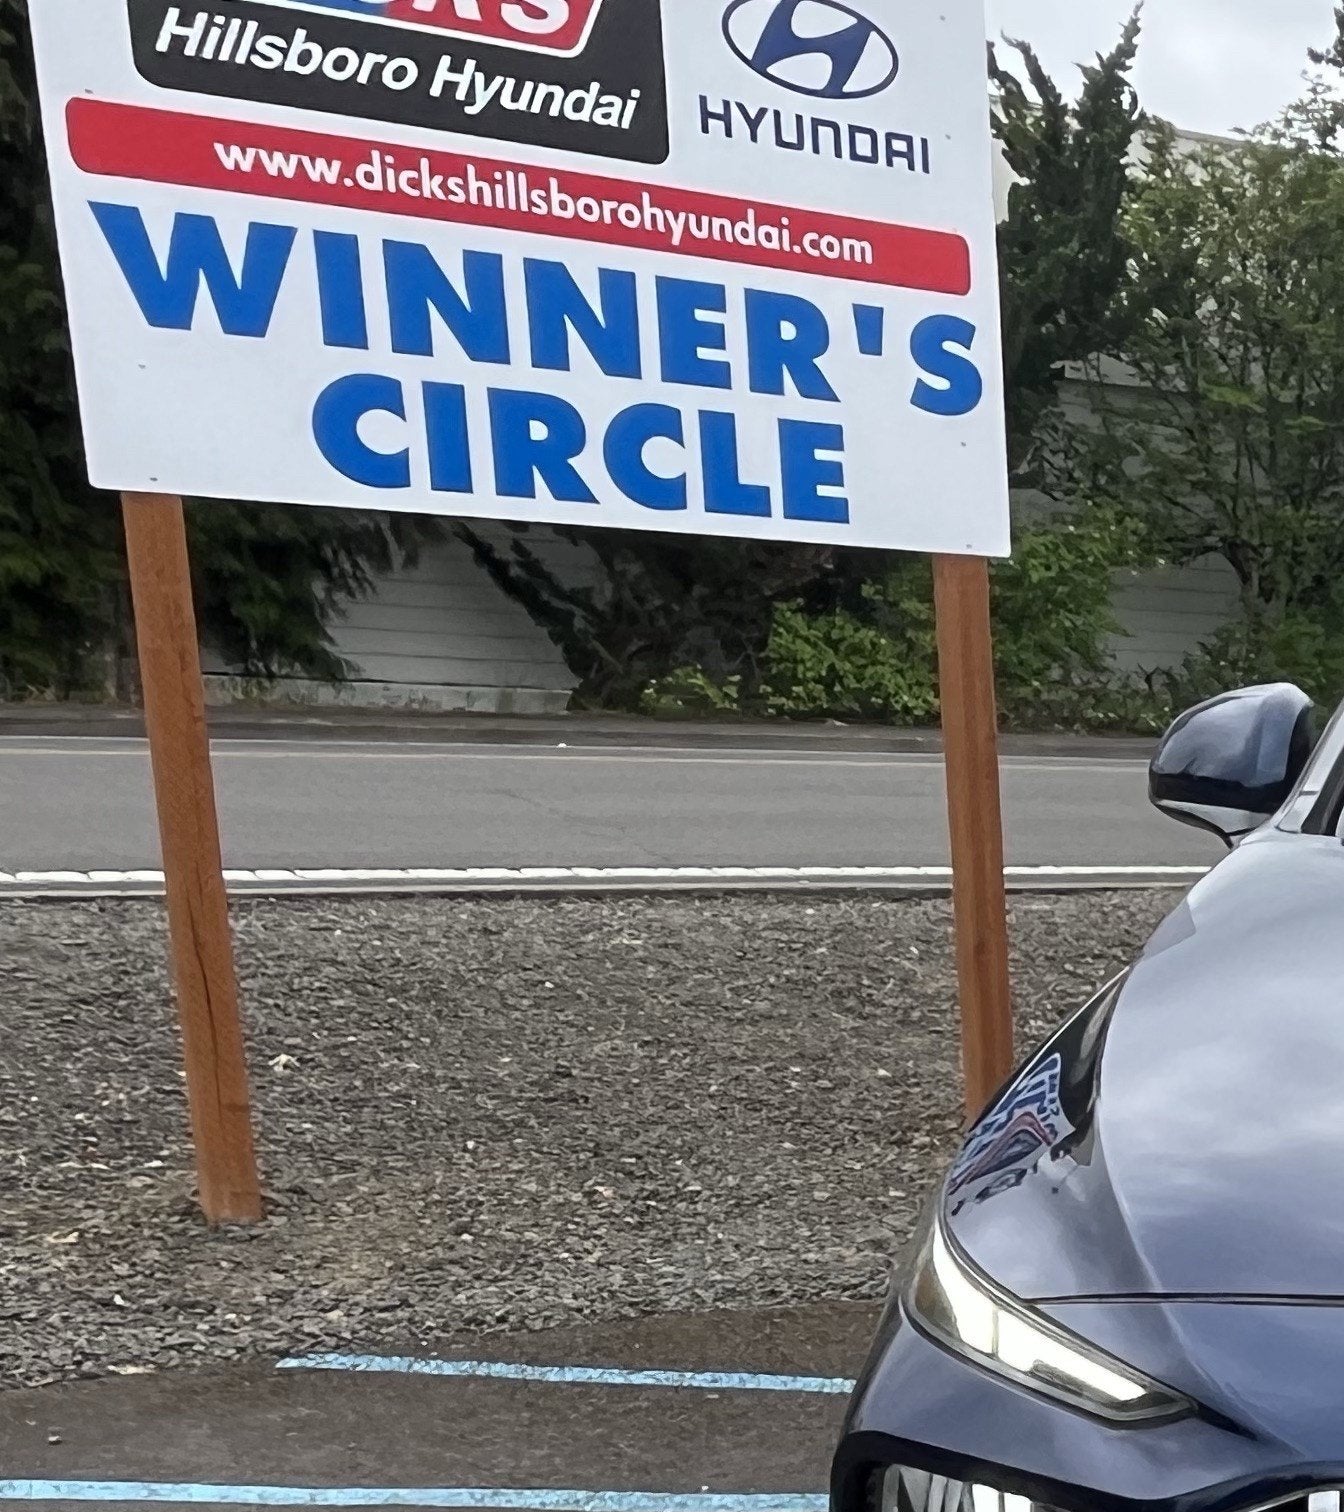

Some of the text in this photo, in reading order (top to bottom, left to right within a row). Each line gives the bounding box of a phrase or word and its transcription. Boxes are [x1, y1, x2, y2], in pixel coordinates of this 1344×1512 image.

[155, 6, 418, 91] Hillsboro
[429, 54, 642, 130] Hyundai
[699, 94, 931, 175] HYUNDAI
[213, 136, 875, 265] www.dickshillsborohyundai.com
[87, 199, 983, 416] WINNER'S
[311, 372, 850, 524] CIRCLE
